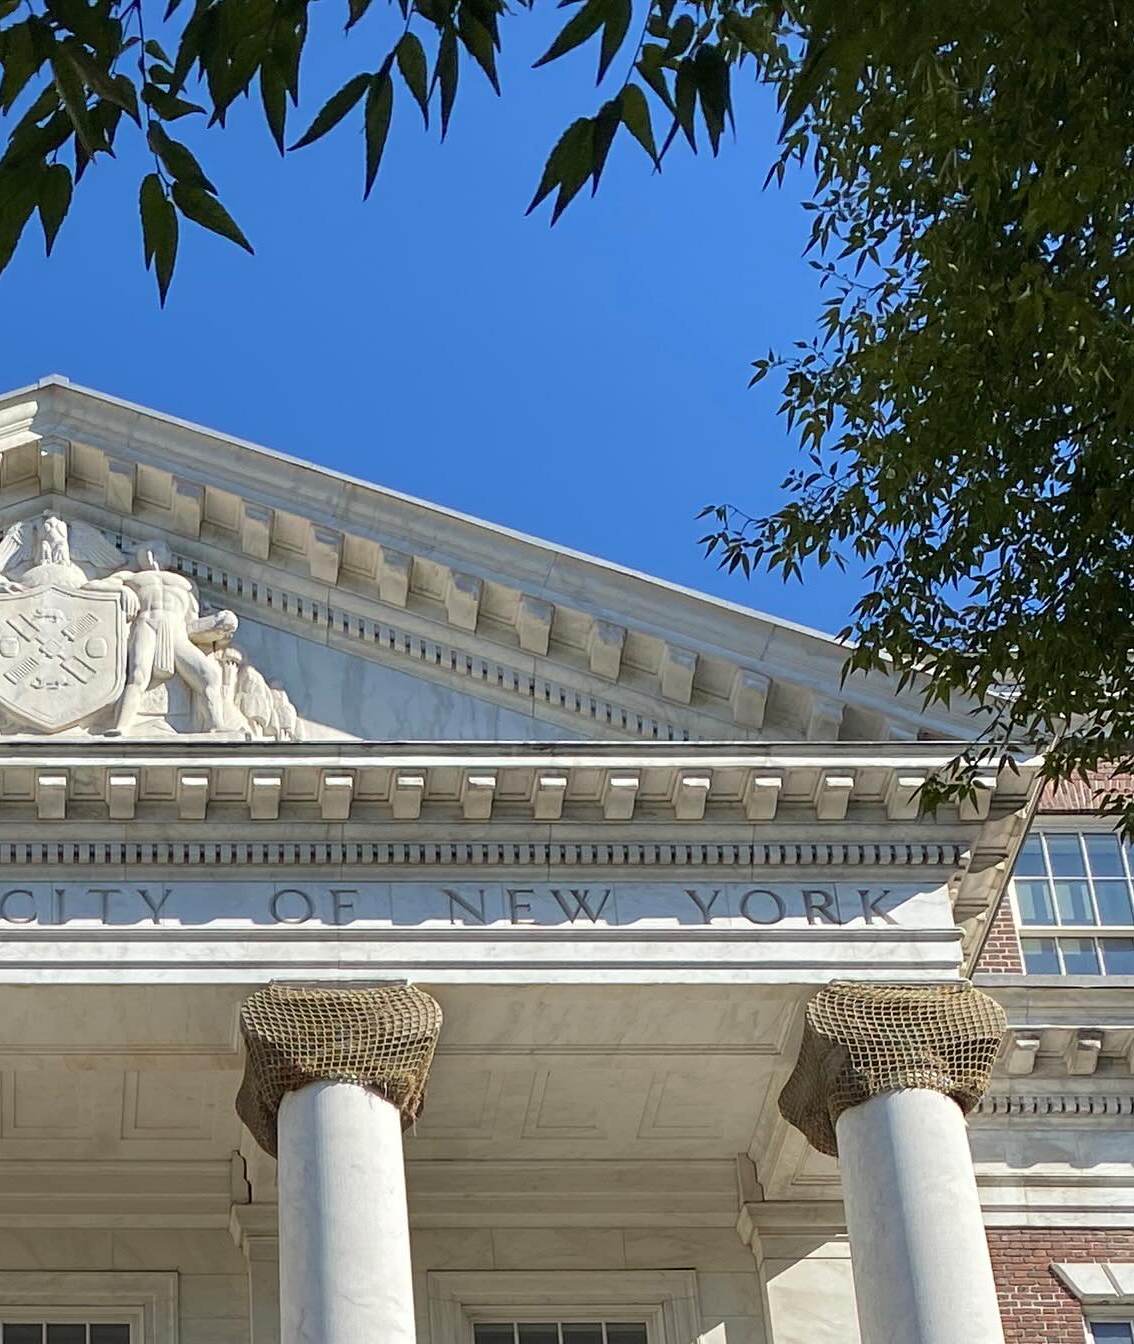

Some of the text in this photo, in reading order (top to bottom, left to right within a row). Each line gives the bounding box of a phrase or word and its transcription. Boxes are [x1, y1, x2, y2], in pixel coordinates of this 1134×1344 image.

[270, 888, 360, 926] OF
[443, 888, 610, 926] NEW
[686, 888, 899, 926] YORK
